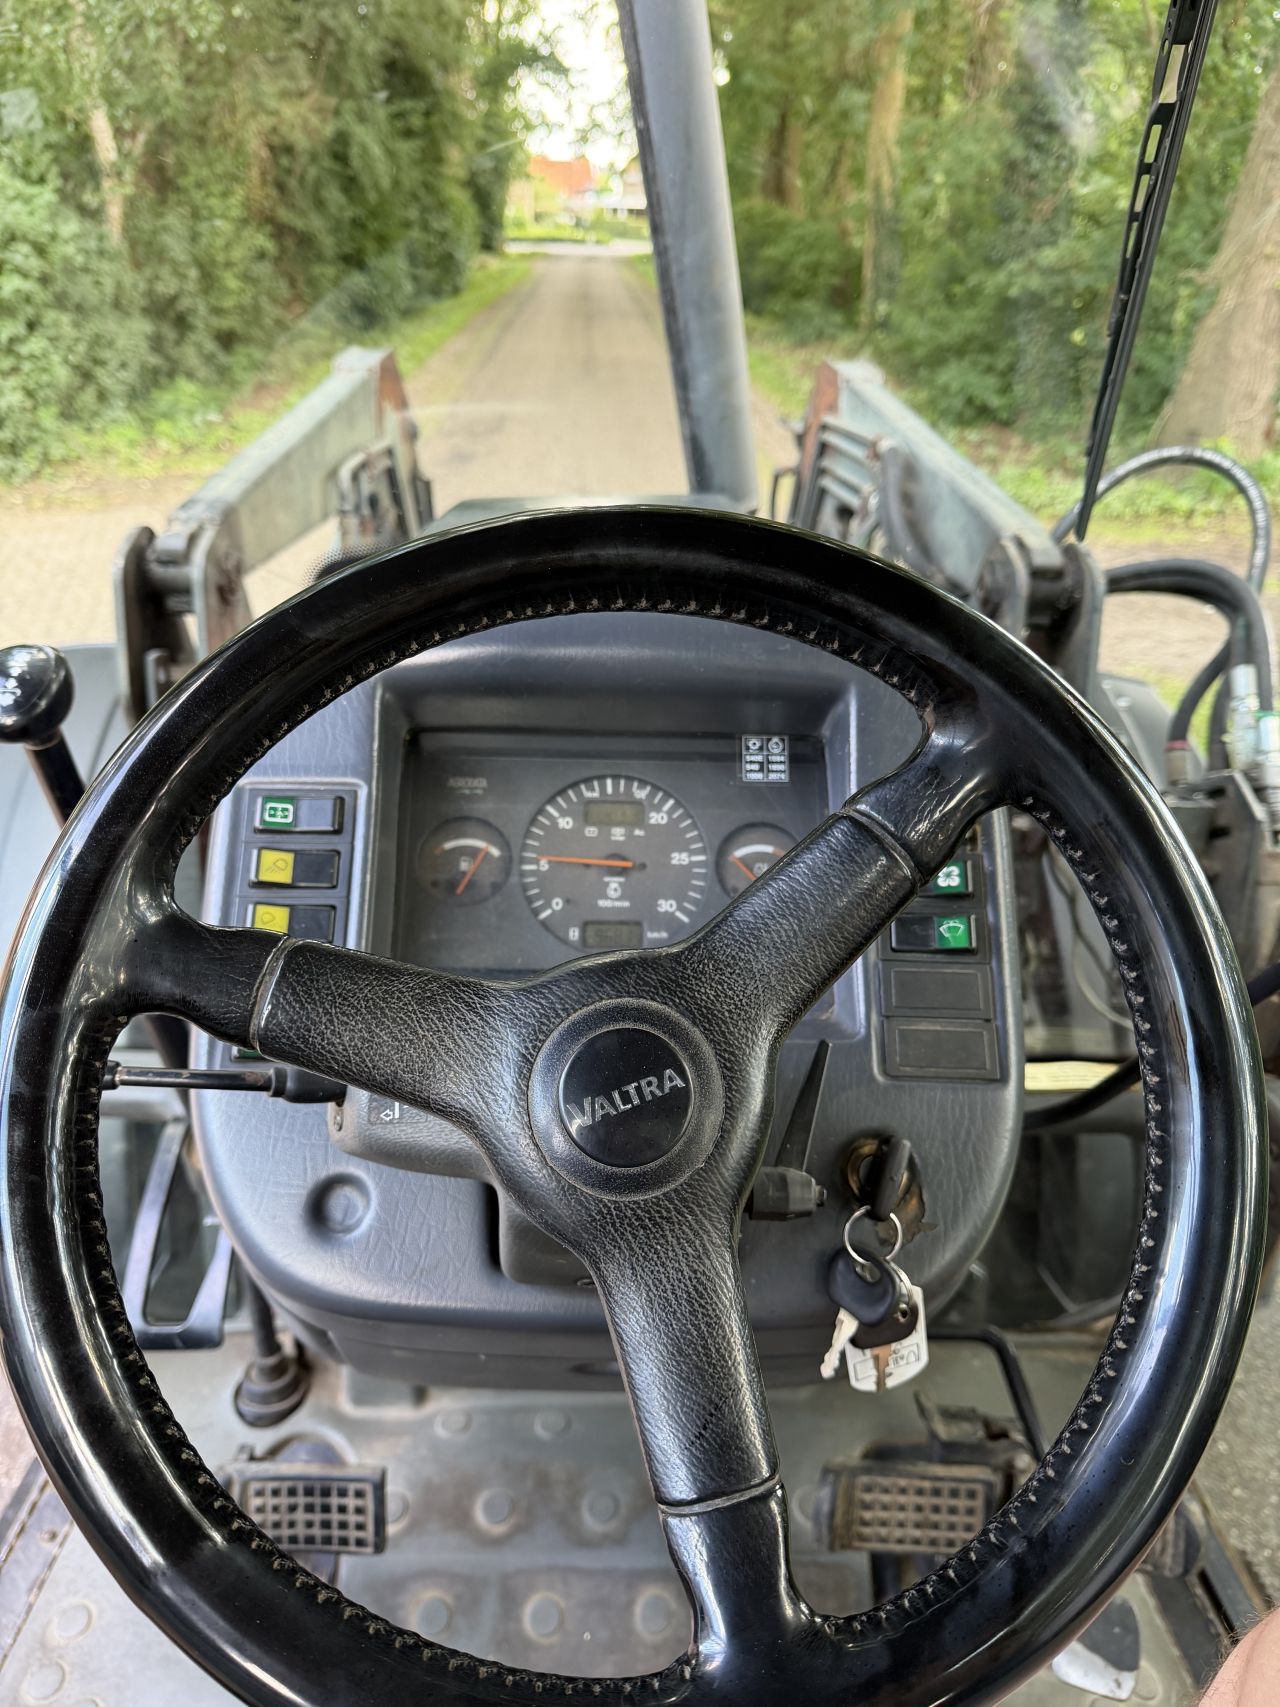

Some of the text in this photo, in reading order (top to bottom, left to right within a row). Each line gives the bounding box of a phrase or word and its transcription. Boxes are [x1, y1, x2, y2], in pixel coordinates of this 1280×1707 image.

[557, 817, 573, 829] 10
[649, 812, 668, 825] 20
[670, 852, 690, 865] 25
[539, 860, 549, 871] 5
[552, 898, 563, 910] 0
[657, 899, 677, 912] 30
[566, 1067, 686, 1127] VALTRA
